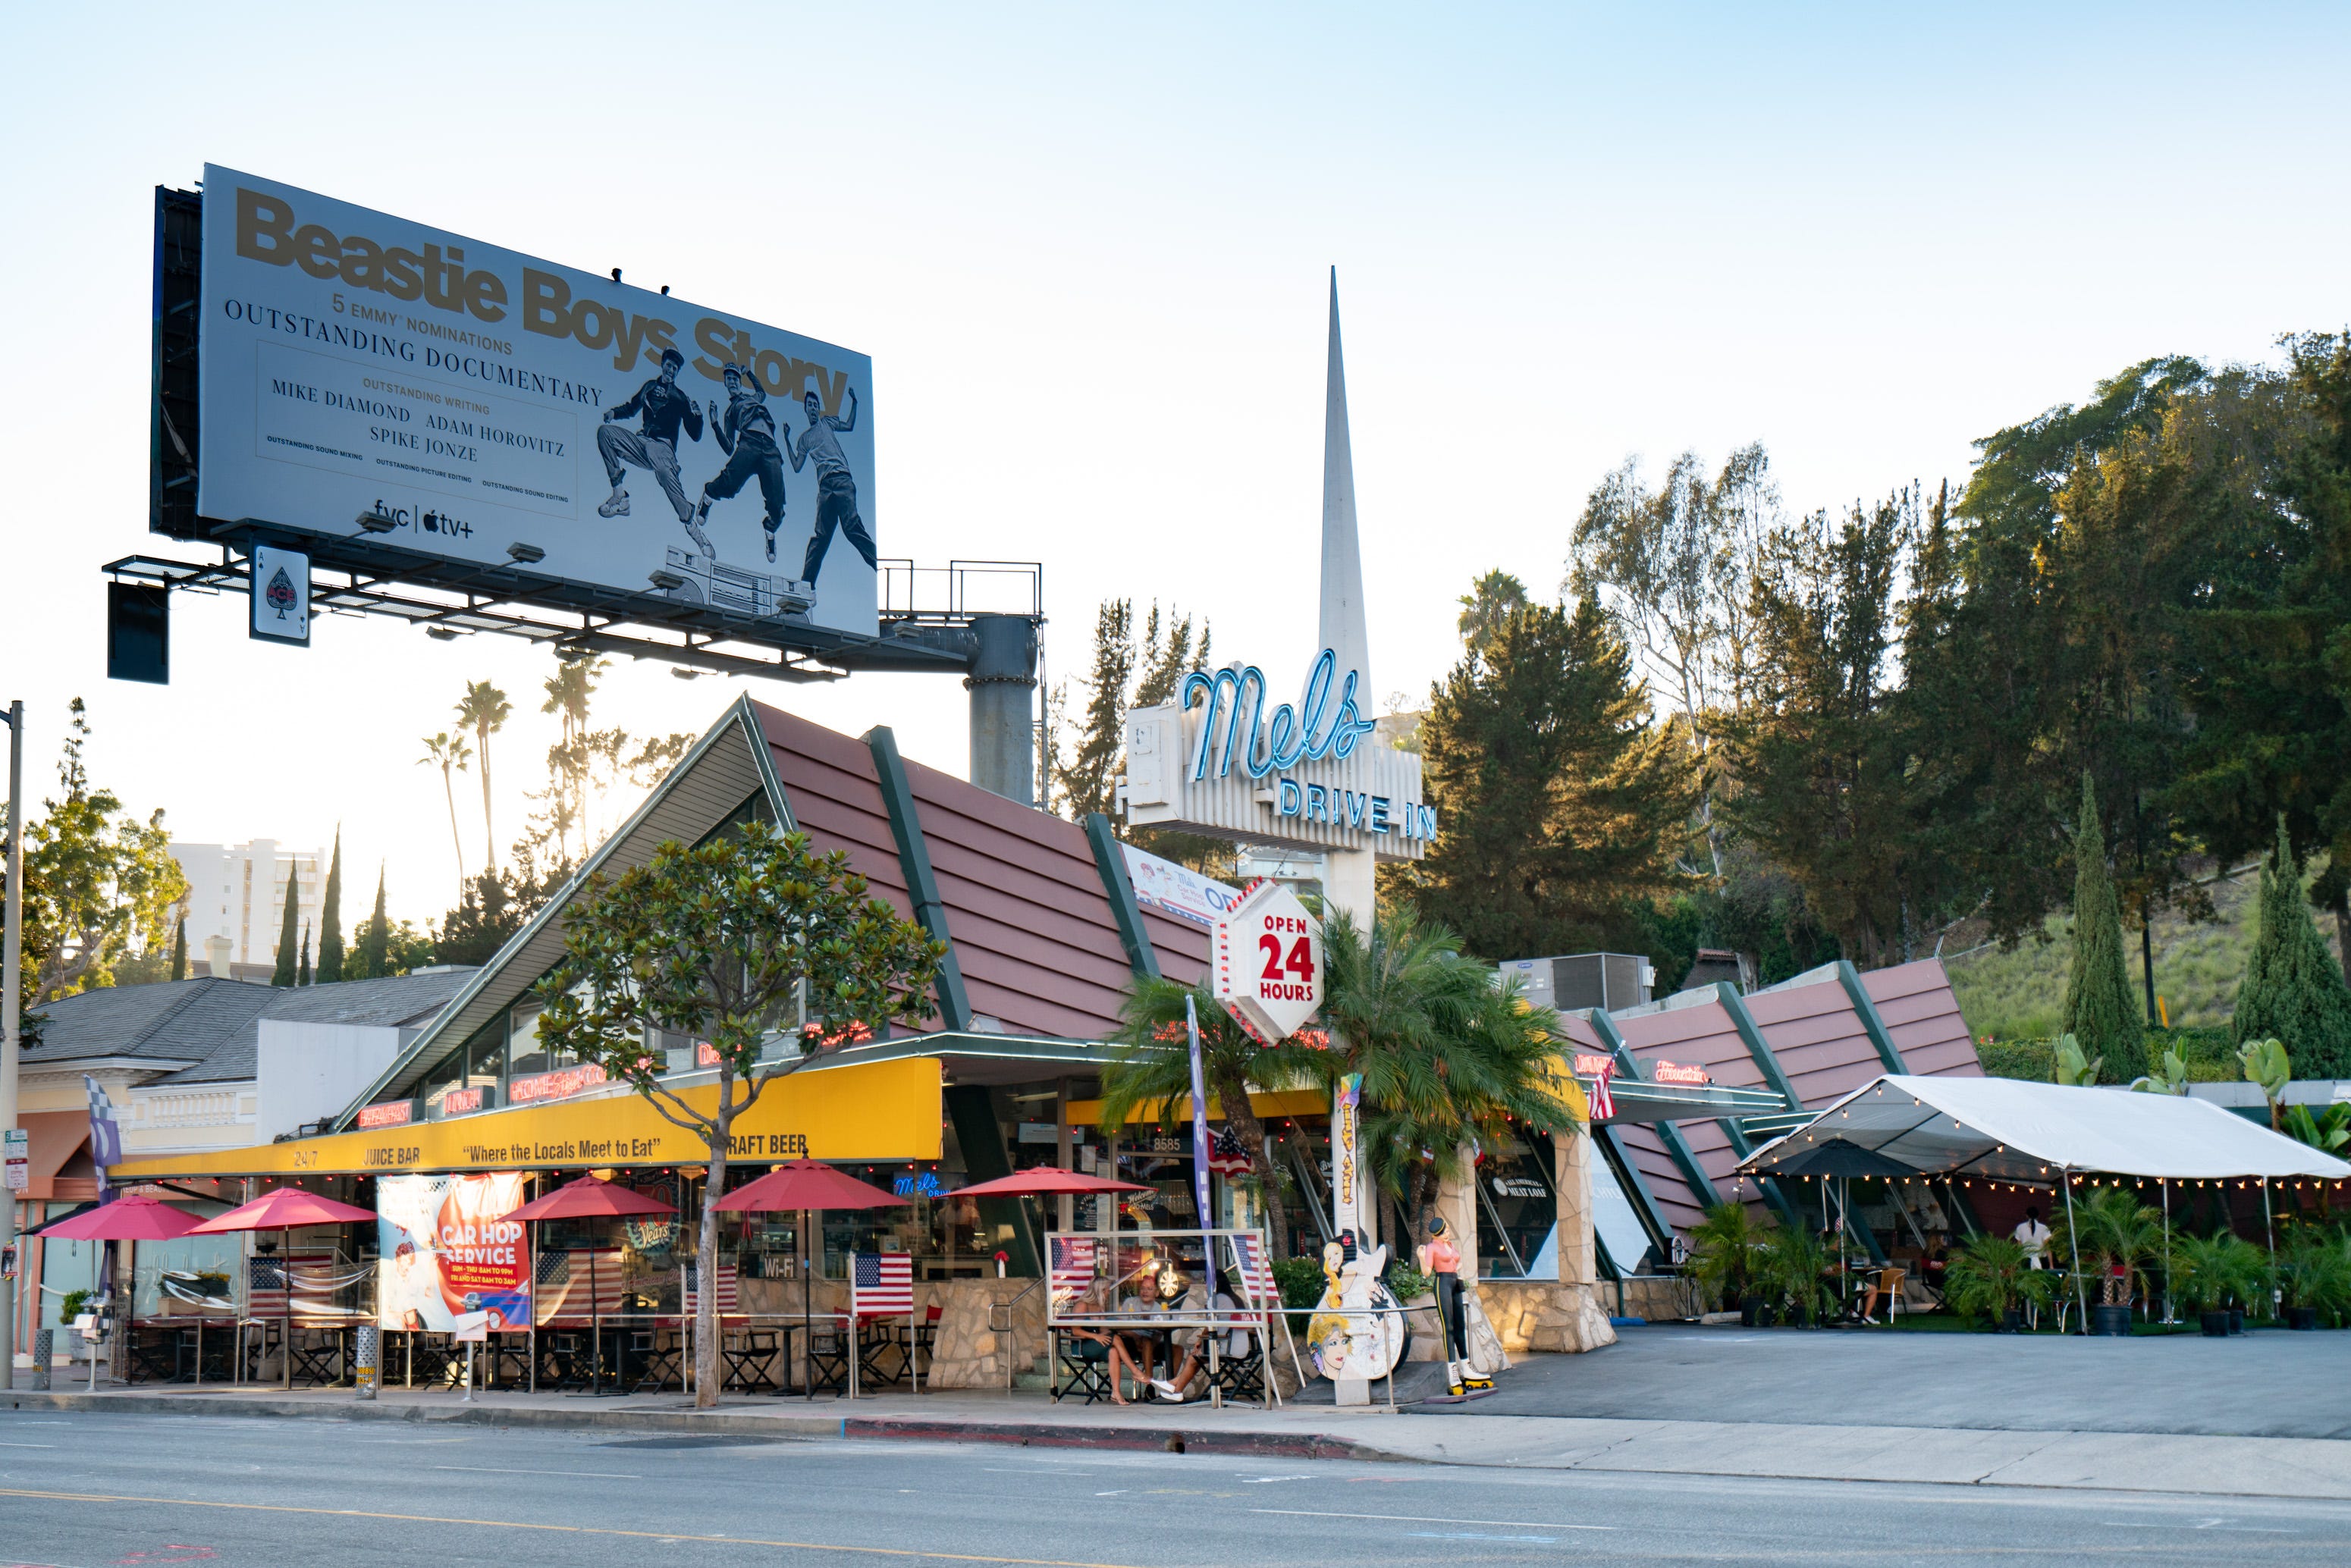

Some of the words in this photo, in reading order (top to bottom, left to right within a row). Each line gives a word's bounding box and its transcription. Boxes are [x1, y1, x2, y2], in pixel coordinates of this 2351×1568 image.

[237, 187, 508, 322] Beastie
[523, 267, 679, 372] Boys
[692, 318, 849, 416] Story
[333, 293, 345, 313] 5
[406, 316, 513, 356] NOMINATIONS
[224, 299, 416, 362] OUTSTANDING
[426, 347, 603, 406] DOCUMENTARY
[363, 378, 441, 403] OUTSTANDING
[445, 397, 490, 415] WRITING
[273, 379, 318, 403] MIKE
[325, 390, 410, 422] DIAMOND
[425, 415, 473, 437] ADAM
[480, 425, 564, 457] HOROVITZ
[267, 435, 314, 450] OUTSTANDING
[315, 446, 338, 456] SOUND
[340, 450, 363, 461] MIXING
[370, 427, 419, 450] SPIKE
[425, 437, 478, 463] JONZE
[376, 458, 420, 473] OUTSTANDING
[421, 467, 447, 478] PICTURE
[447, 473, 472, 484] EDITING
[482, 480, 524, 494] OUTSTANDING
[525, 489, 545, 498] SOUND
[546, 493, 569, 503] EDITING
[375, 500, 409, 527] fvc
[439, 513, 473, 539] tv+
[259, 551, 264, 561] A
[268, 587, 295, 601] ACE
[1182, 648, 1376, 781] Mels
[1279, 778, 1389, 833] DRIVE
[1406, 801, 1437, 842] IN
[1264, 915, 1306, 934] OPEN
[1260, 933, 1314, 983] 24
[1260, 982, 1313, 1002] HOURS
[445, 1089, 480, 1113] LUNCH
[359, 1102, 410, 1127] BREAKFAST
[363, 1148, 394, 1165] JUICE
[397, 1147, 420, 1165] BAR
[511, 1143, 531, 1161] the
[535, 1140, 575, 1160] Locals
[579, 1140, 612, 1158] Meet
[616, 1139, 628, 1157] to
[728, 1135, 764, 1155] RAFT
[770, 1134, 807, 1154] BEER
[1154, 1138, 1181, 1151] 8585
[294, 1150, 318, 1168] 24/7
[895, 1173, 940, 1196] Mels
[1508, 1187, 1528, 1196] MEAT
[1527, 1187, 1546, 1198] LOAF
[442, 1225, 476, 1246] CAR
[481, 1223, 523, 1244] HOP
[638, 1225, 668, 1250] Years
[447, 1247, 516, 1265] SERVICE
[764, 1257, 794, 1278] Wi-Fi
